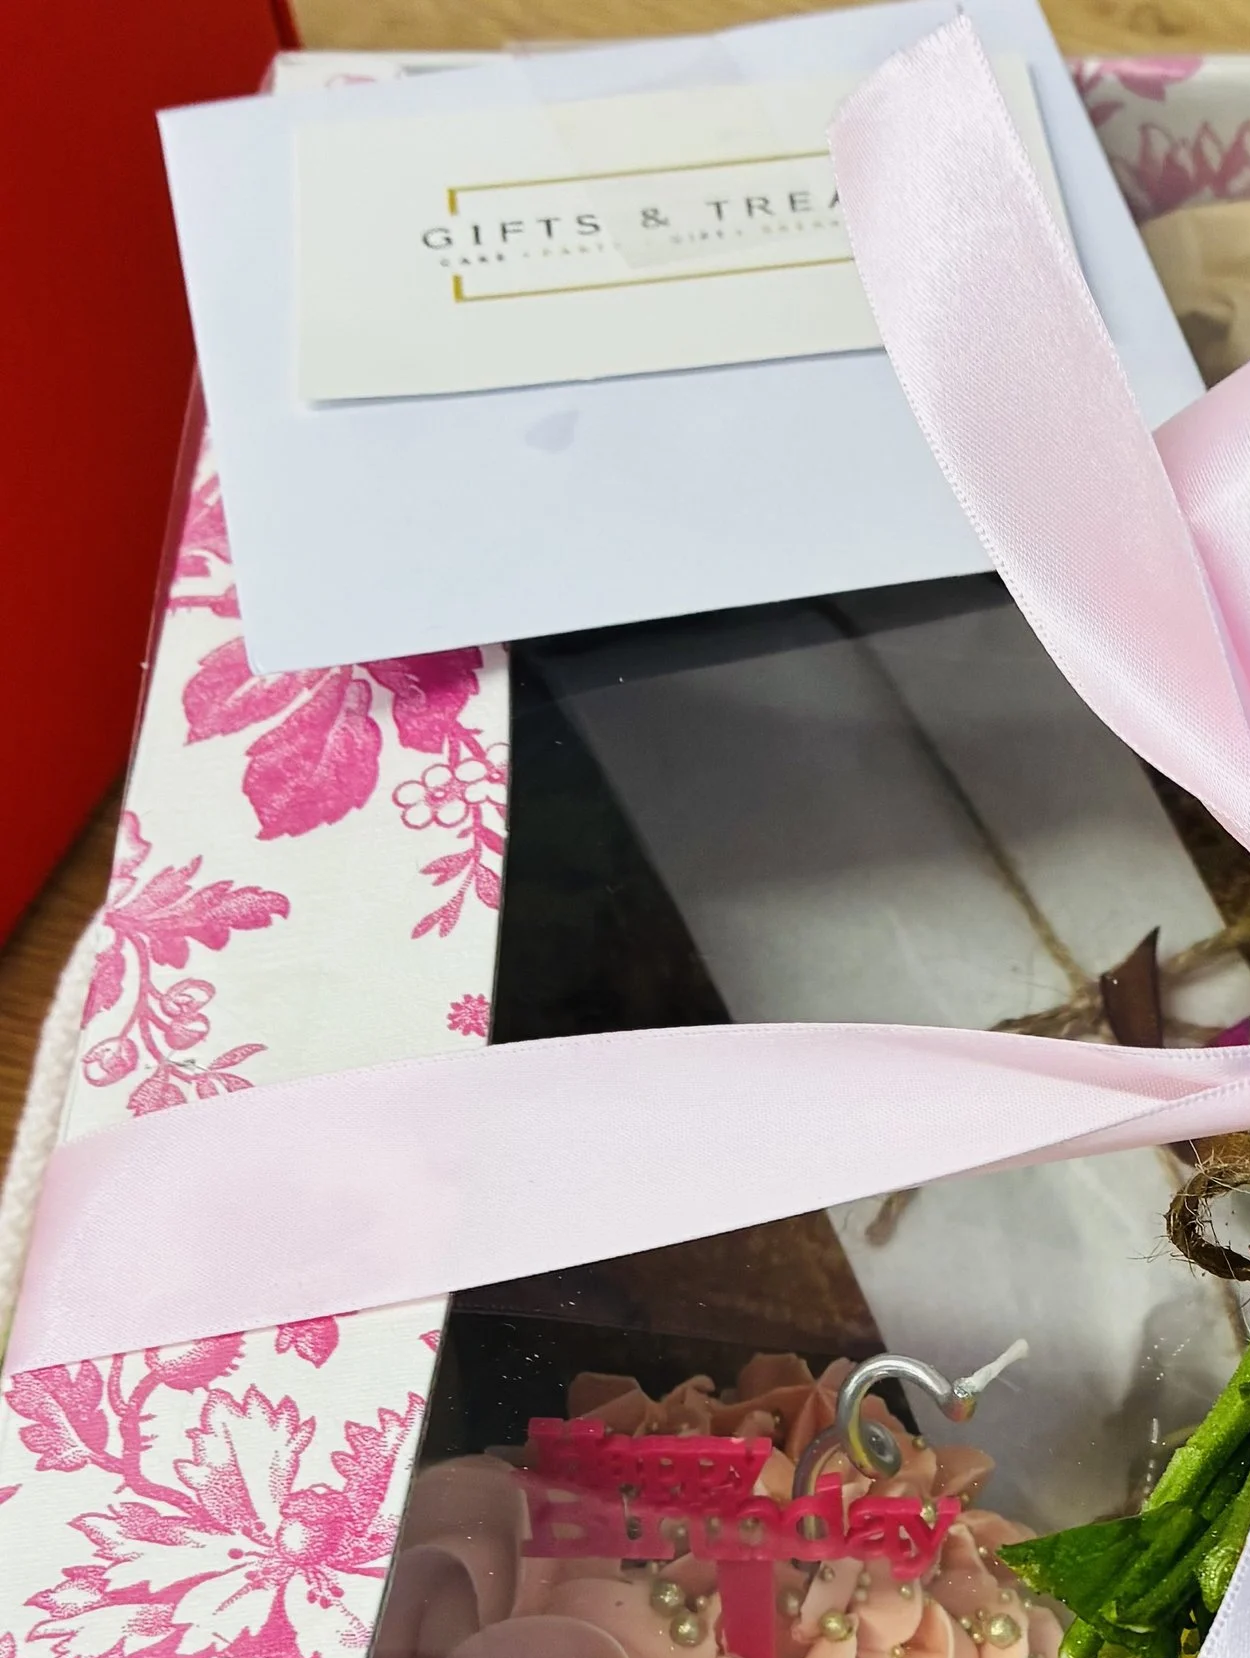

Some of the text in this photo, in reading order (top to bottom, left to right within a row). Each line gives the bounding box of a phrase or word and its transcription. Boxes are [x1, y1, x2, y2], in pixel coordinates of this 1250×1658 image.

[422, 214, 602, 250] GIFTS
[641, 208, 670, 229] &
[705, 190, 841, 221] TREA
